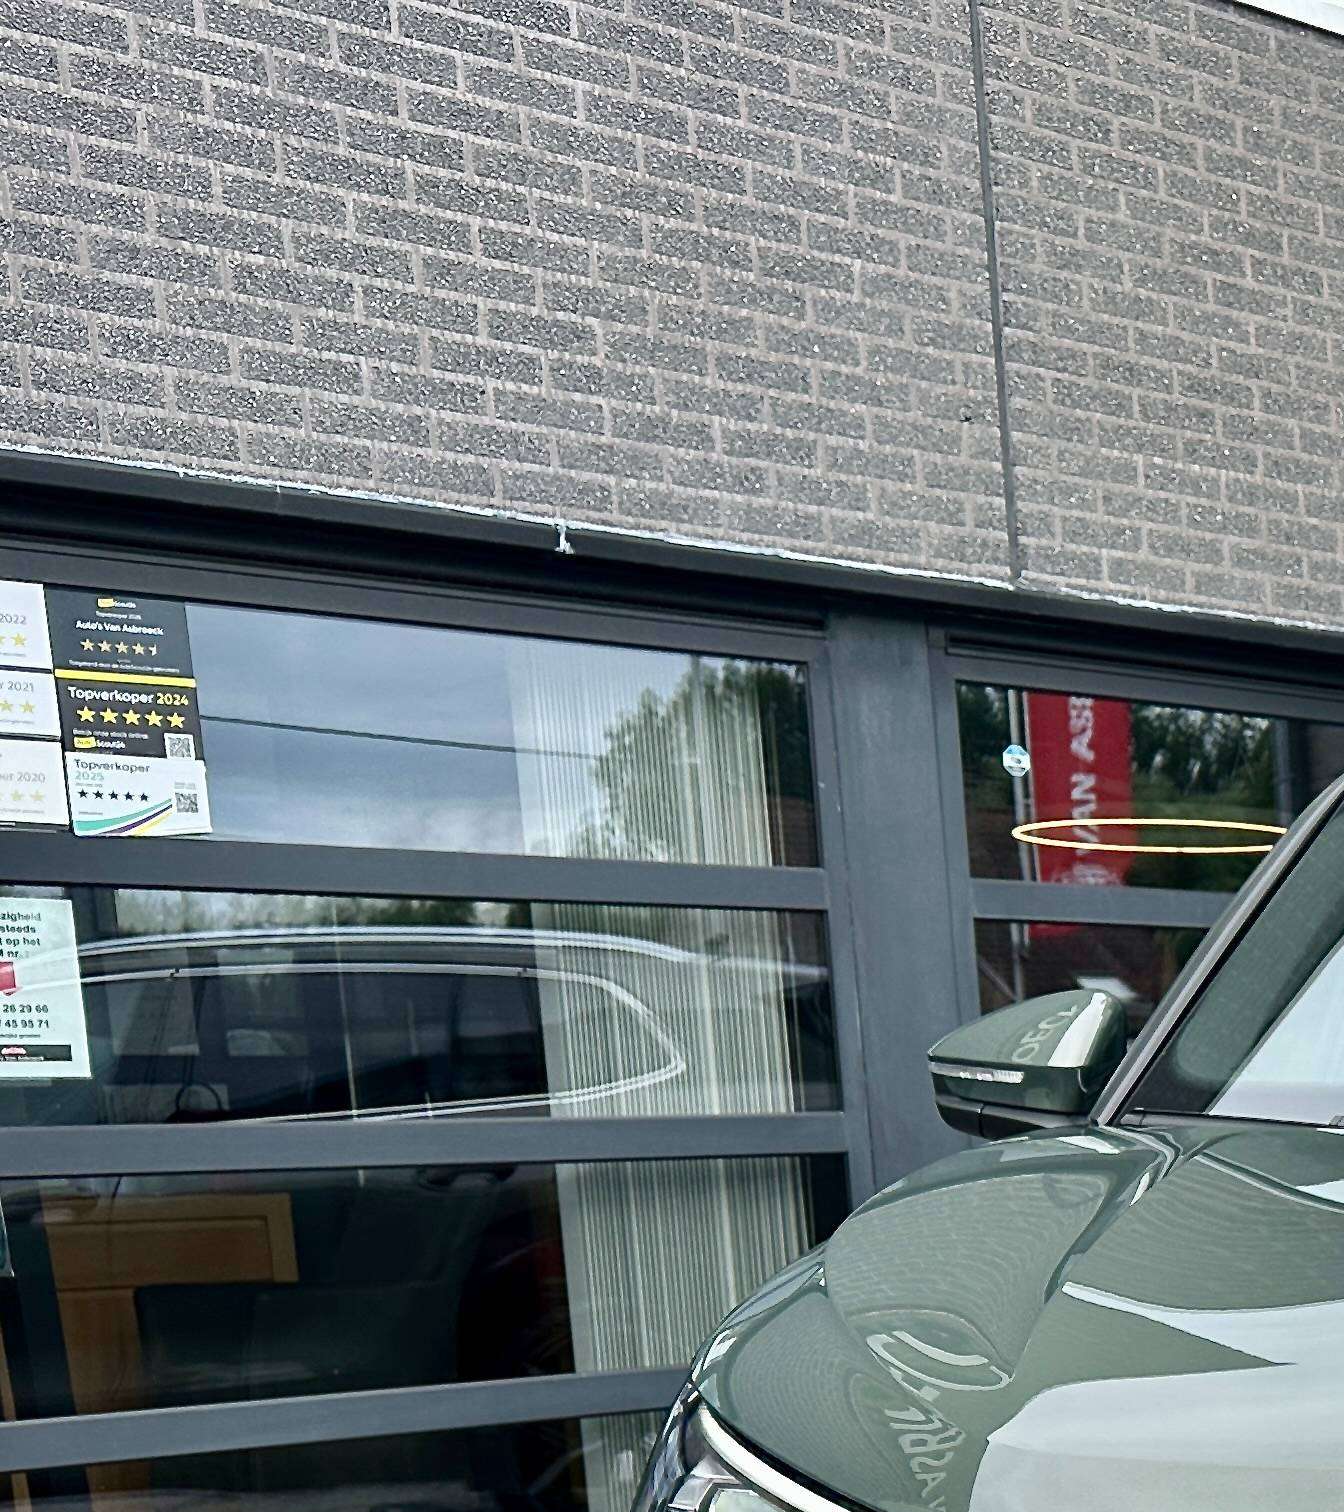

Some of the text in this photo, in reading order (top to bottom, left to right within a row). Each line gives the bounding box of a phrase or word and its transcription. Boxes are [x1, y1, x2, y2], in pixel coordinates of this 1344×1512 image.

[67, 686, 189, 706] Topverkoper 2024
[74, 758, 150, 774] Topverkoper
